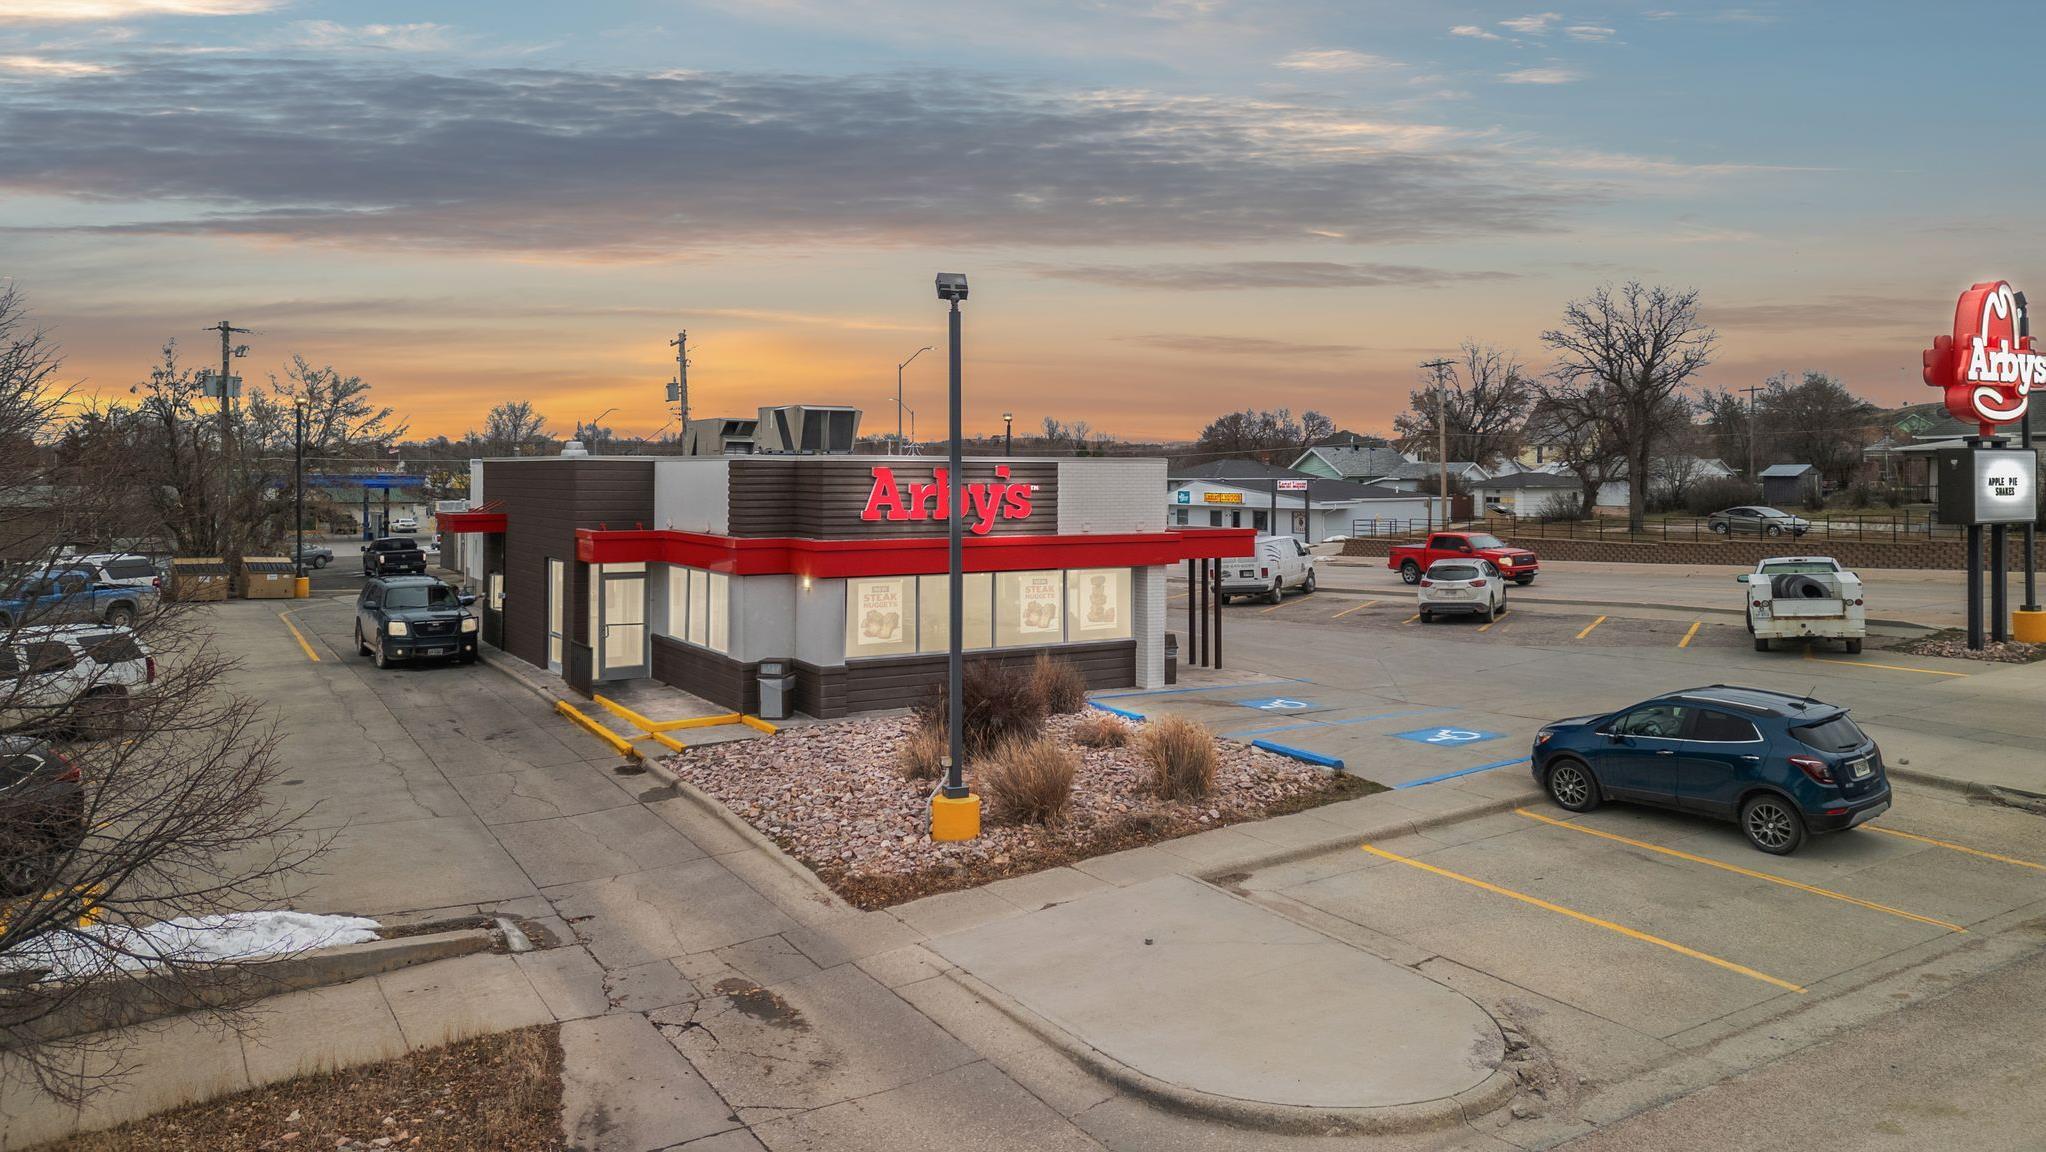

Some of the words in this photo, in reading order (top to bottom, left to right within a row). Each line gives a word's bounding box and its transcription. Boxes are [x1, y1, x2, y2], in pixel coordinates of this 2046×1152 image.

[1988, 477, 2004, 486] APPLE
[2008, 477, 2018, 486] PIE
[1995, 487, 2015, 496] SHAKES
[1025, 584, 1055, 593] STEAK
[864, 592, 897, 602] STEAK
